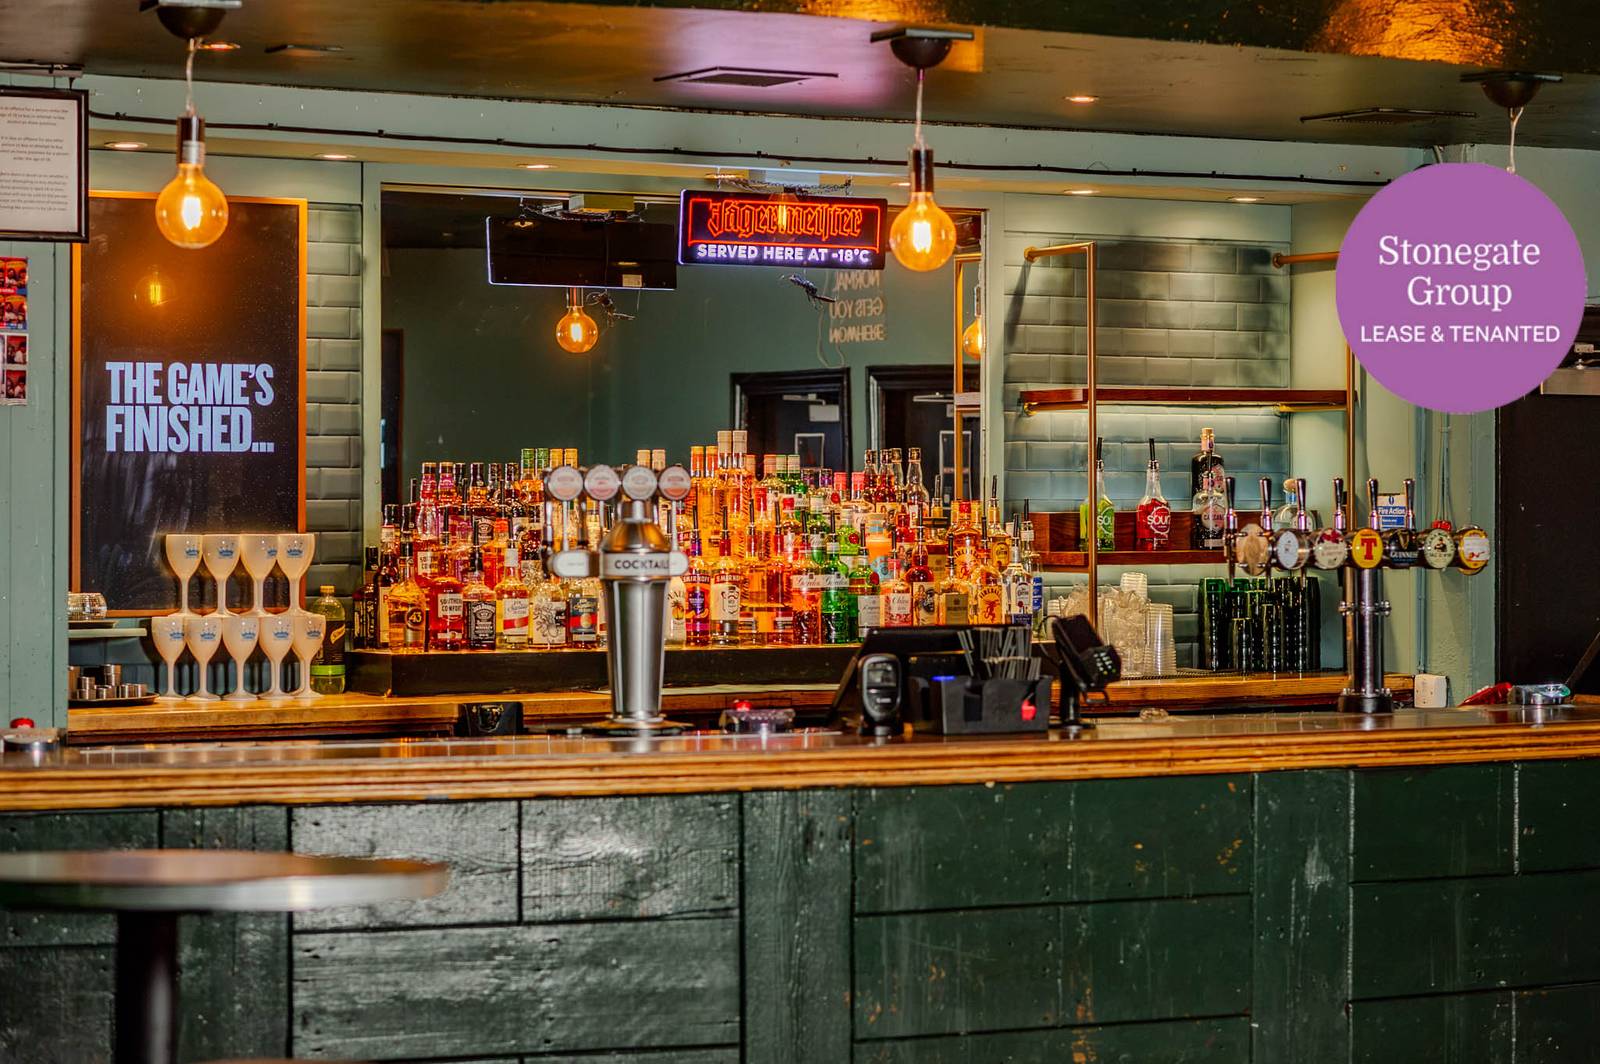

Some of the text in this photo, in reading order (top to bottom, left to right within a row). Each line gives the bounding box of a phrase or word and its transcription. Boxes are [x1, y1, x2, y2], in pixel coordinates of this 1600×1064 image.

[707, 200, 863, 242] Jägermeister
[697, 244, 870, 263] SERVED HERE AT -18°C
[105, 361, 275, 406] THE GAME'S
[105, 405, 275, 452] FINISHED...
[1360, 538, 1377, 560] T
[408, 611, 423, 623] 43
